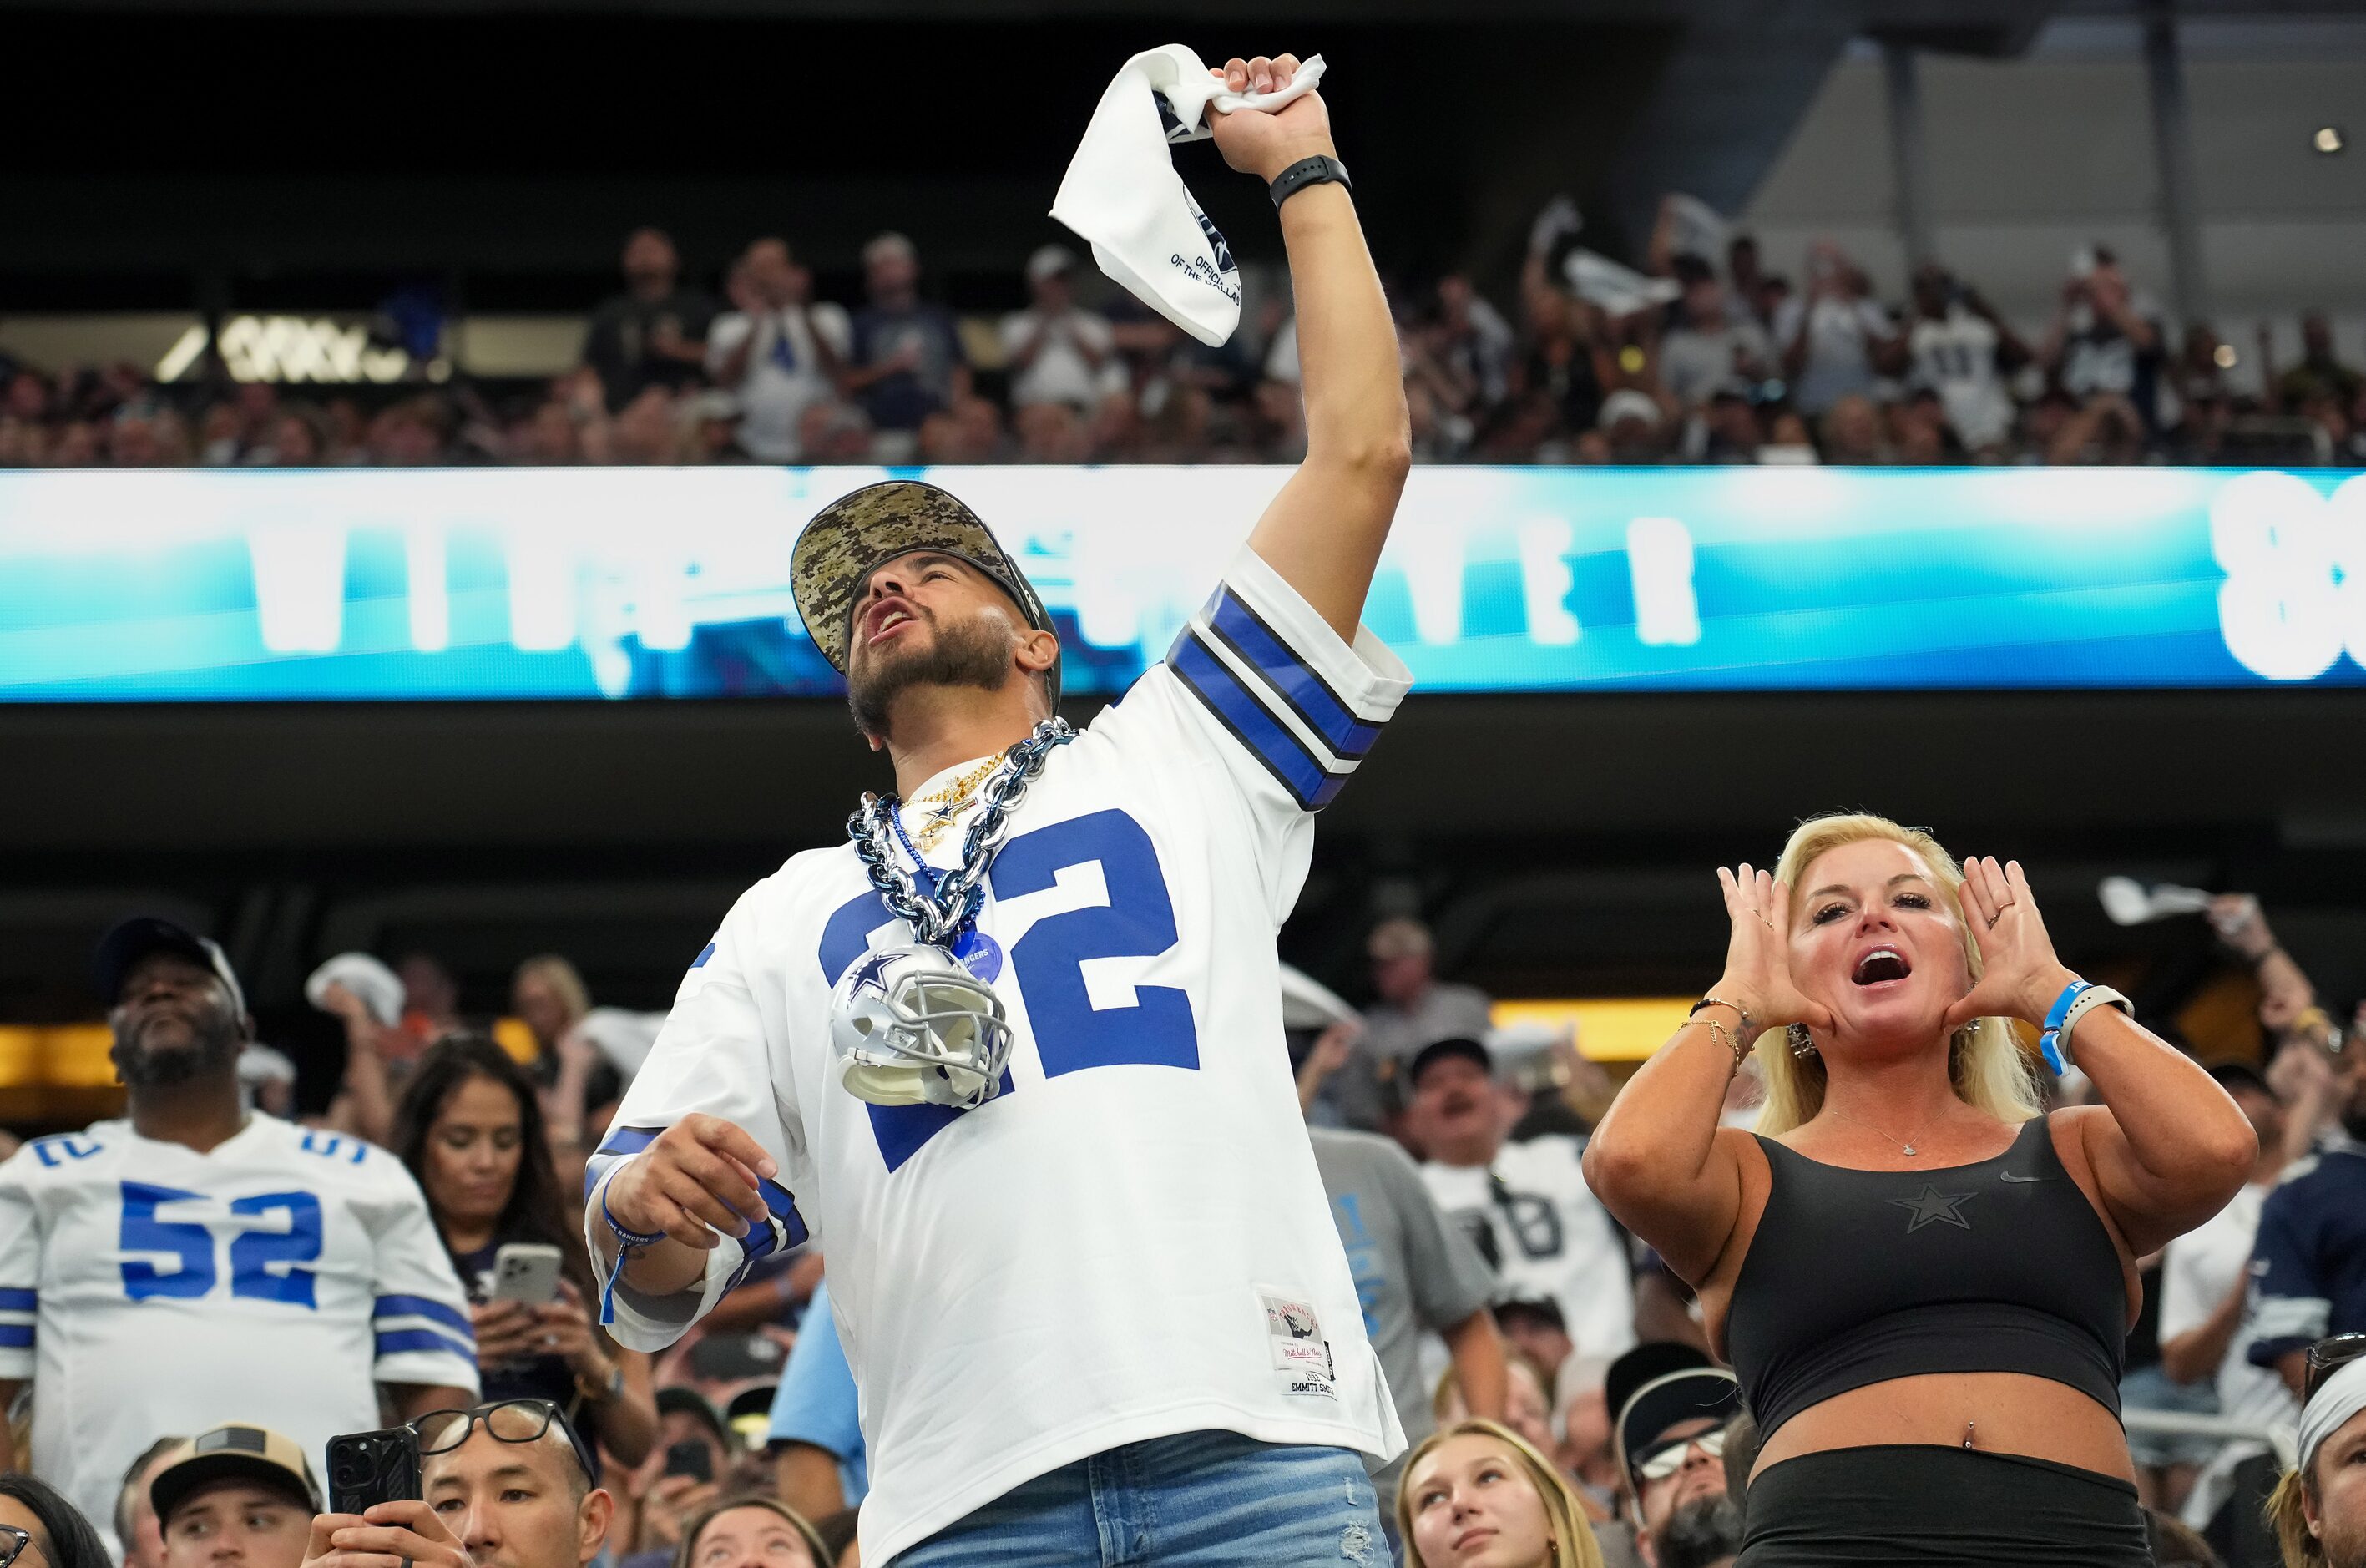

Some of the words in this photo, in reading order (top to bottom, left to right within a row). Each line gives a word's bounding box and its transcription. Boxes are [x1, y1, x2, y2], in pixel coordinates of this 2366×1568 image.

[1170, 253, 1186, 268] OF
[1184, 264, 1202, 282] THE
[959, 948, 989, 965] ANGERS
[119, 1180, 323, 1310] 52
[618, 1230, 650, 1242] RANGERS
[1279, 1303, 1319, 1329] THROWBACKS
[1292, 1383, 1317, 1392] EMMITT
